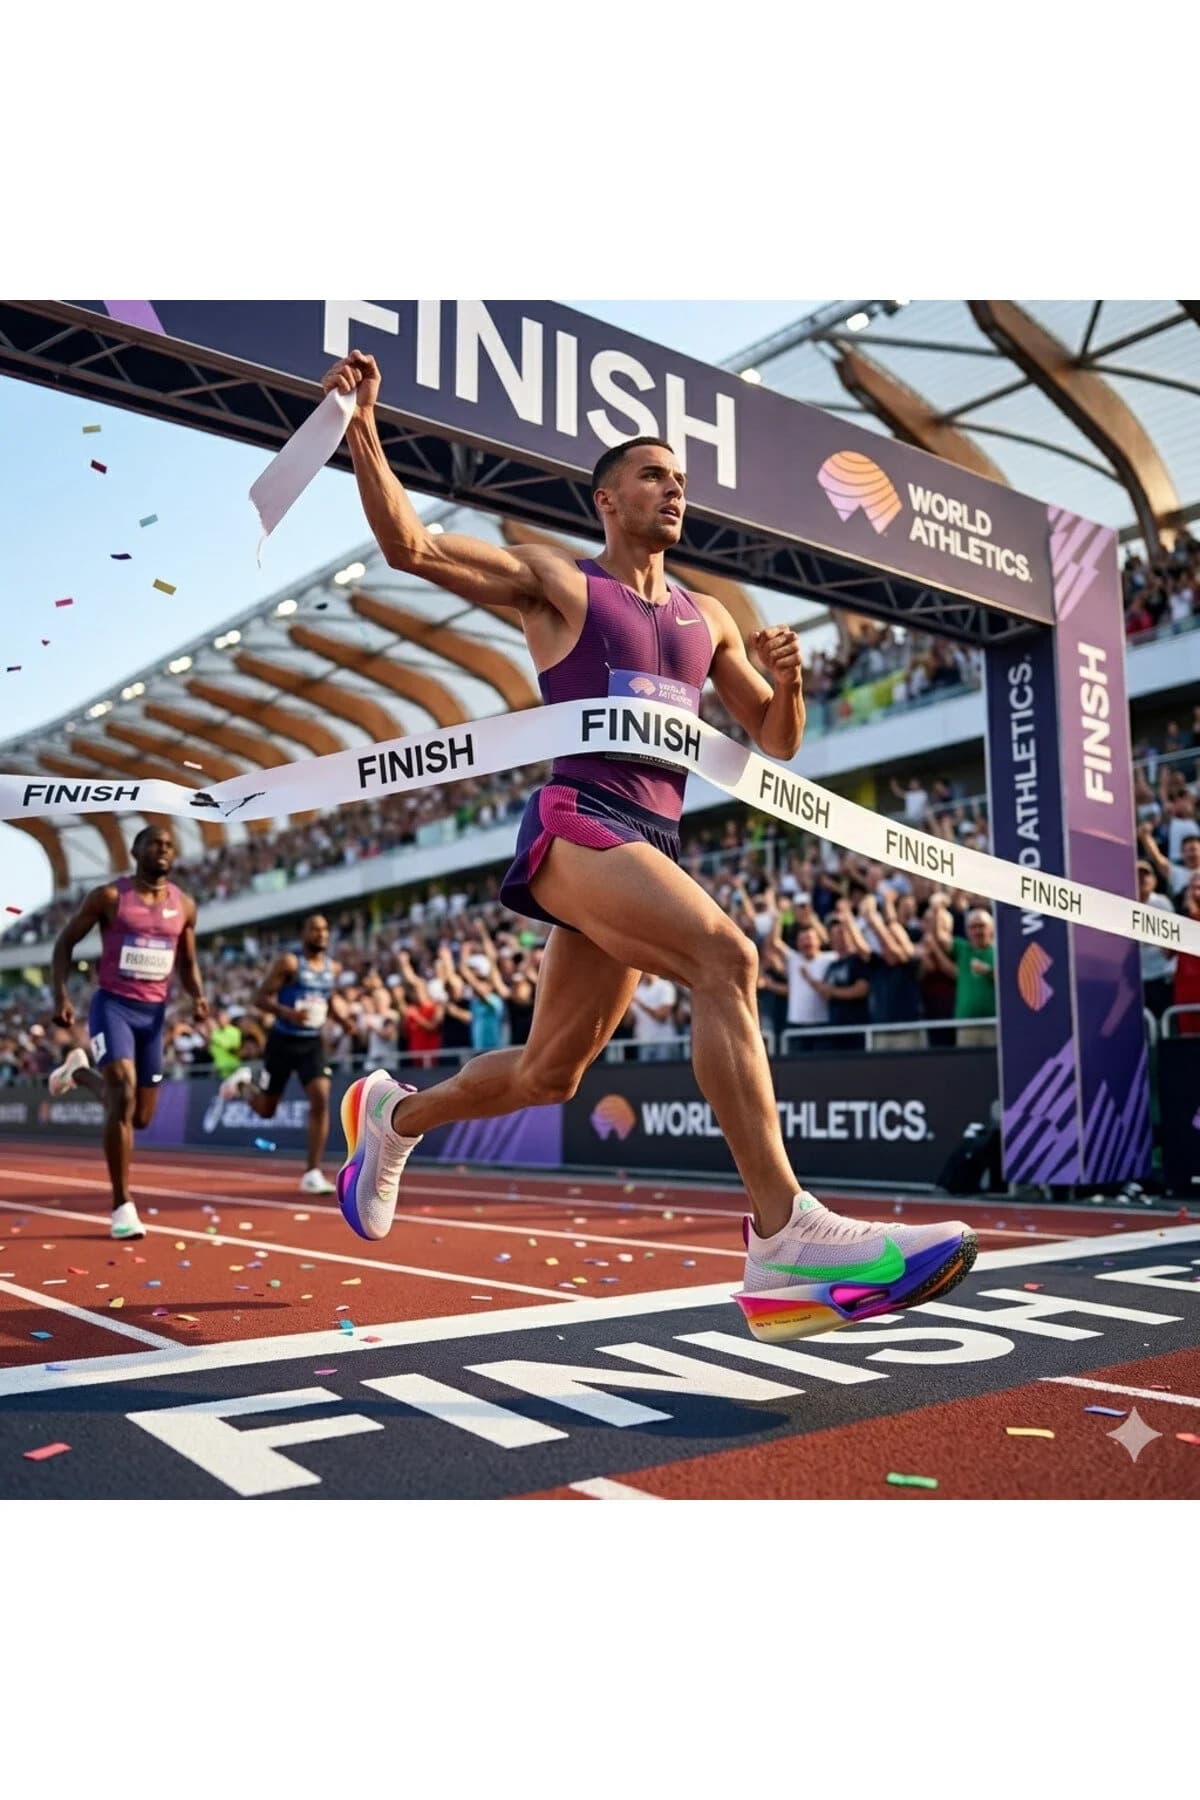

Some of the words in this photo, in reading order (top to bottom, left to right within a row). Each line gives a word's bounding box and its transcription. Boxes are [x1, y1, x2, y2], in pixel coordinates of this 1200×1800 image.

[907, 482, 992, 537] WORLD
[581, 708, 701, 762] FINISH
[1077, 642, 1114, 805] FINSH
[357, 733, 474, 789] FINISH
[22, 784, 140, 807] FINISH
[759, 769, 830, 829] FINISH
[886, 829, 955, 877] FINISH
[1020, 876, 1082, 915] FINISH
[1131, 910, 1181, 943] FINISH
[641, 1102, 723, 1137] WORL
[775, 1100, 934, 1141] THLETICS.
[125, 1288, 1186, 1497] FINISH
